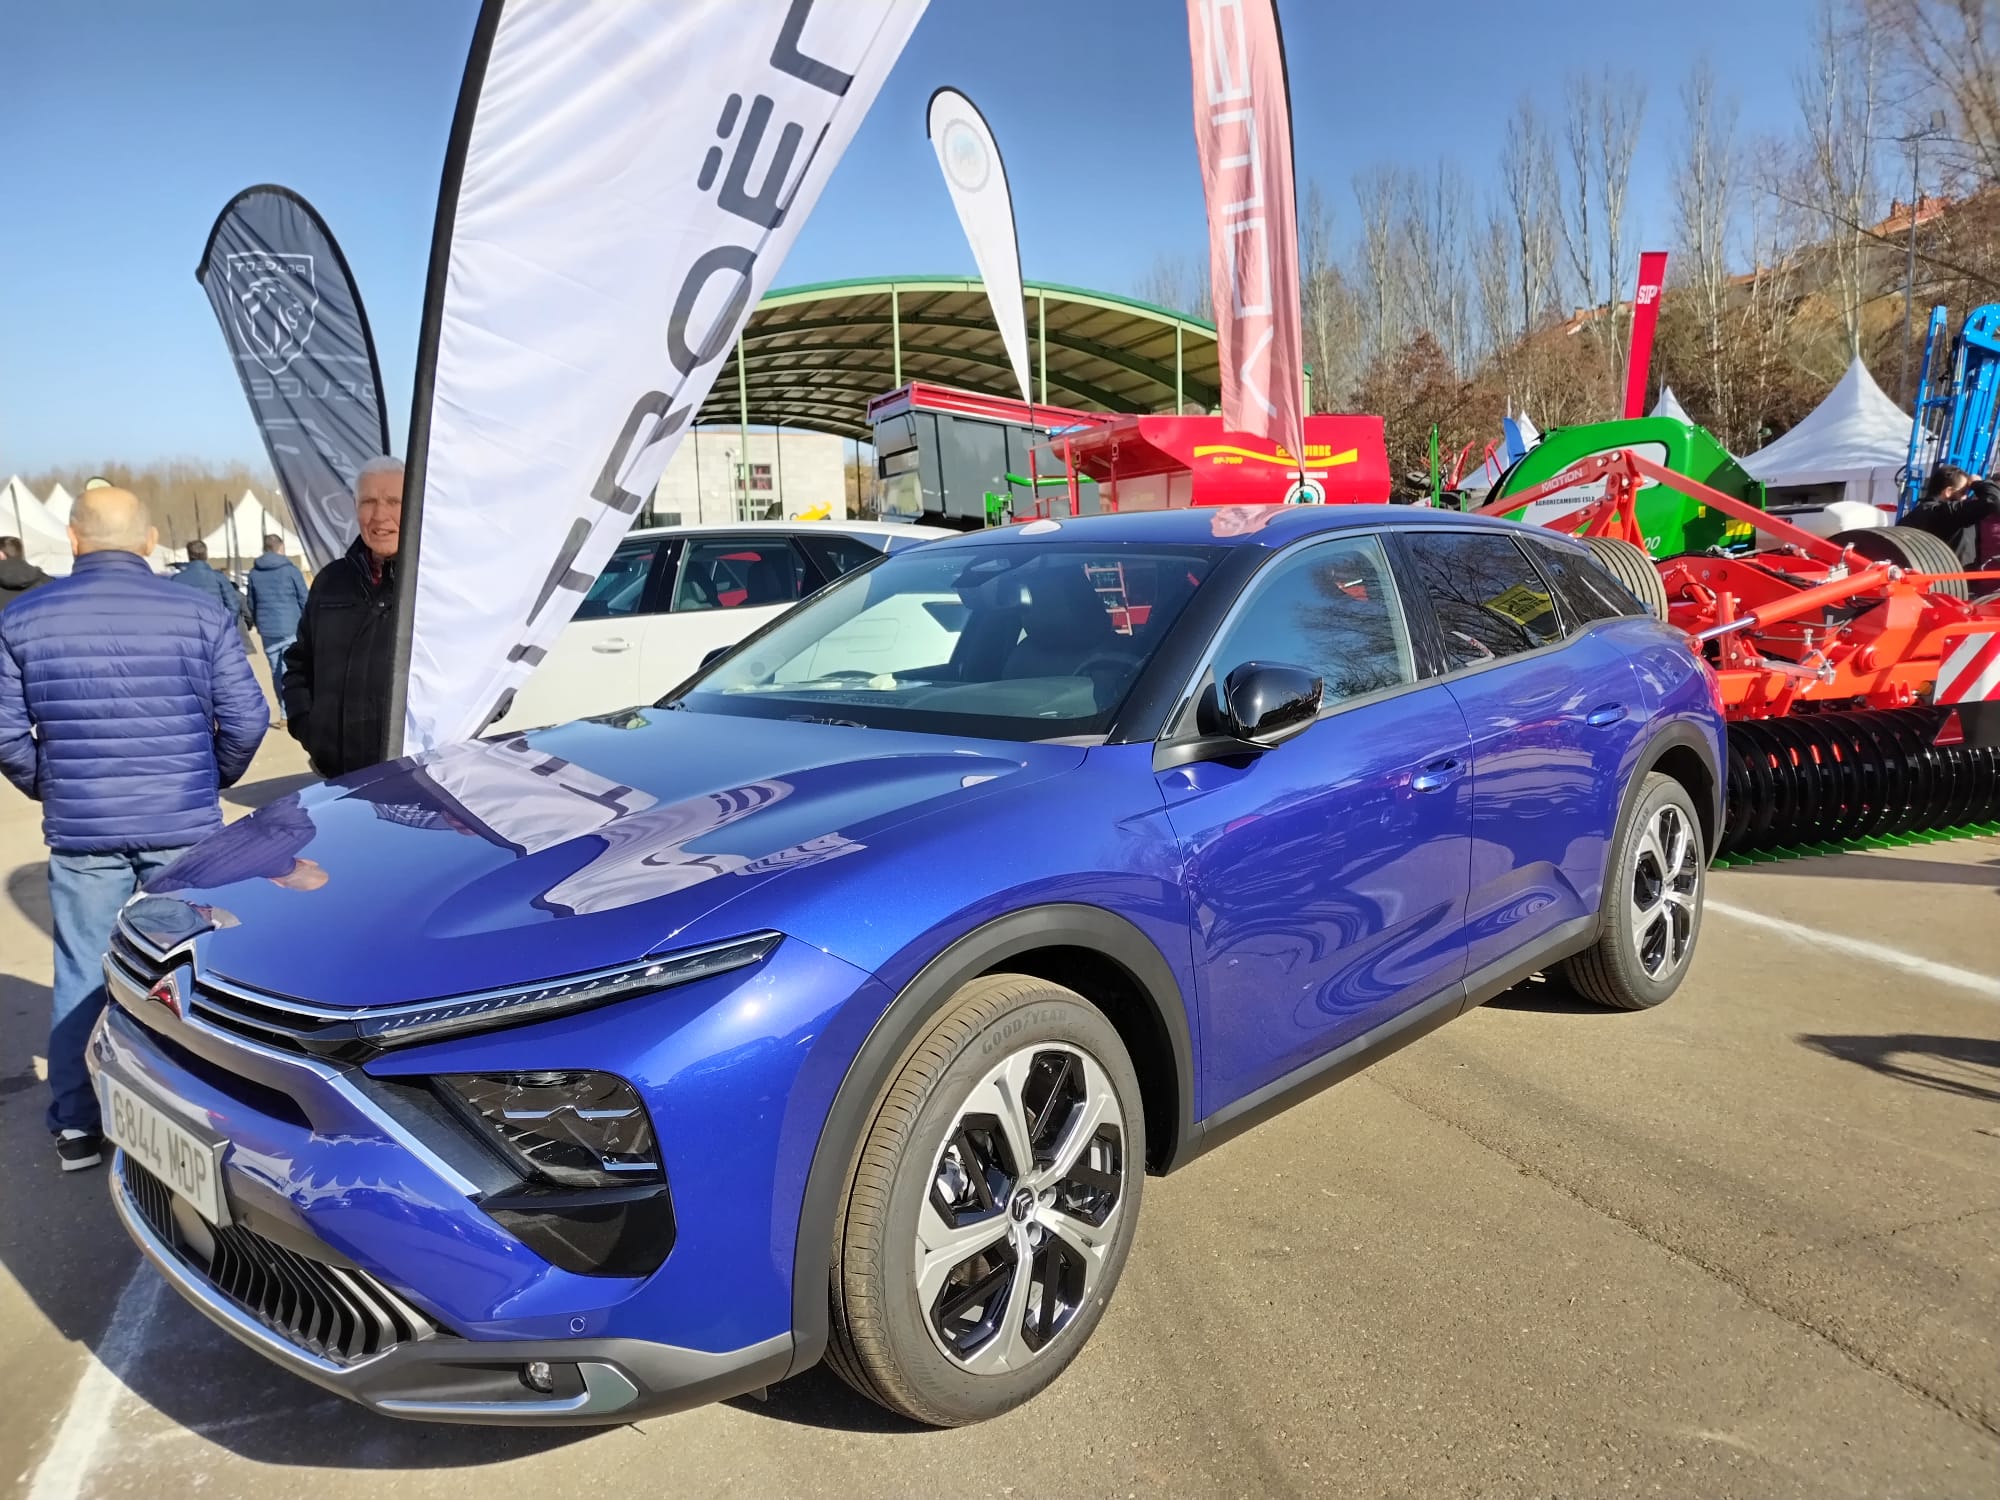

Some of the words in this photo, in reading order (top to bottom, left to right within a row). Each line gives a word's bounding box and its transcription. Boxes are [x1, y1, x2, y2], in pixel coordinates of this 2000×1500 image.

[1637, 285, 1658, 304] SIP
[1541, 467, 1584, 493] MOTION
[1536, 496, 1581, 506] AGRORECAMBIOS
[1644, 535, 1661, 551] 00
[982, 1008, 1067, 1055] GOODYEAR
[113, 1089, 163, 1170] 6844
[167, 1127, 207, 1201] MDP
